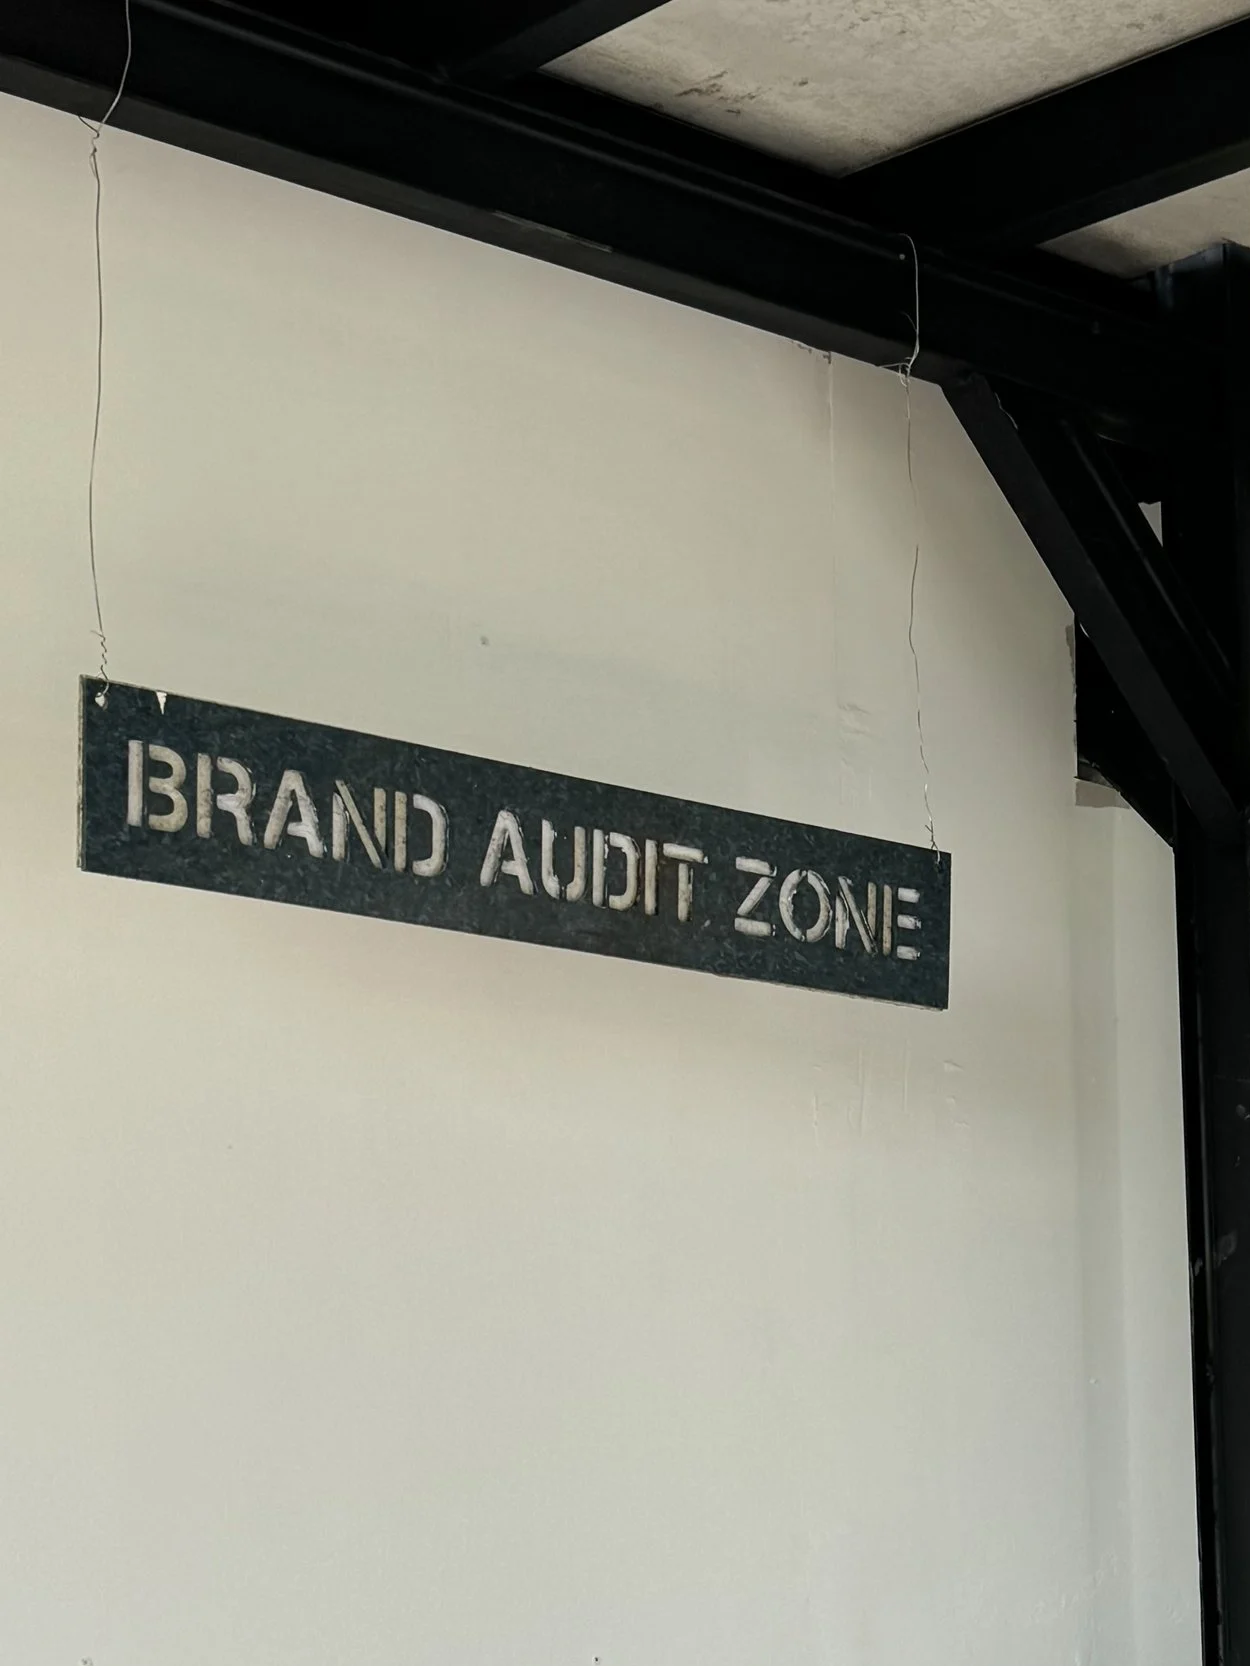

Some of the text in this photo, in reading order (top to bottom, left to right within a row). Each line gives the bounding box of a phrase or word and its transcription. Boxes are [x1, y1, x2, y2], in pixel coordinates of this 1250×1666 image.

[127, 740, 921, 961] BRAND AUDIT ZONE
